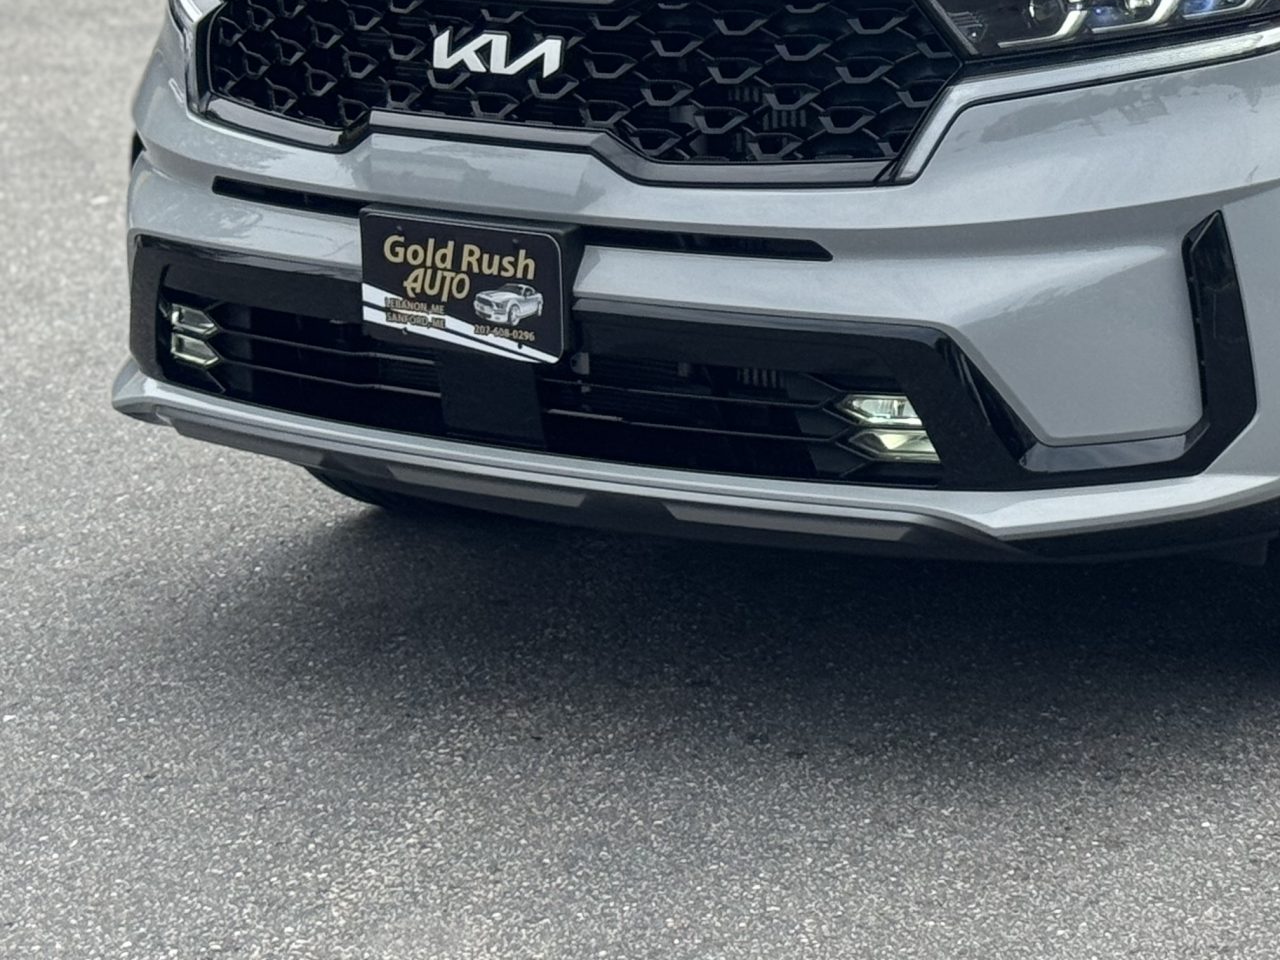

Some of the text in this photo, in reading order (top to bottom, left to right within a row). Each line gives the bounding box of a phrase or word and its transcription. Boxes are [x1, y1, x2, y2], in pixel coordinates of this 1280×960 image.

[433, 28, 562, 79] KIA
[383, 234, 536, 280] Gold Rush
[403, 267, 470, 303] AUTO
